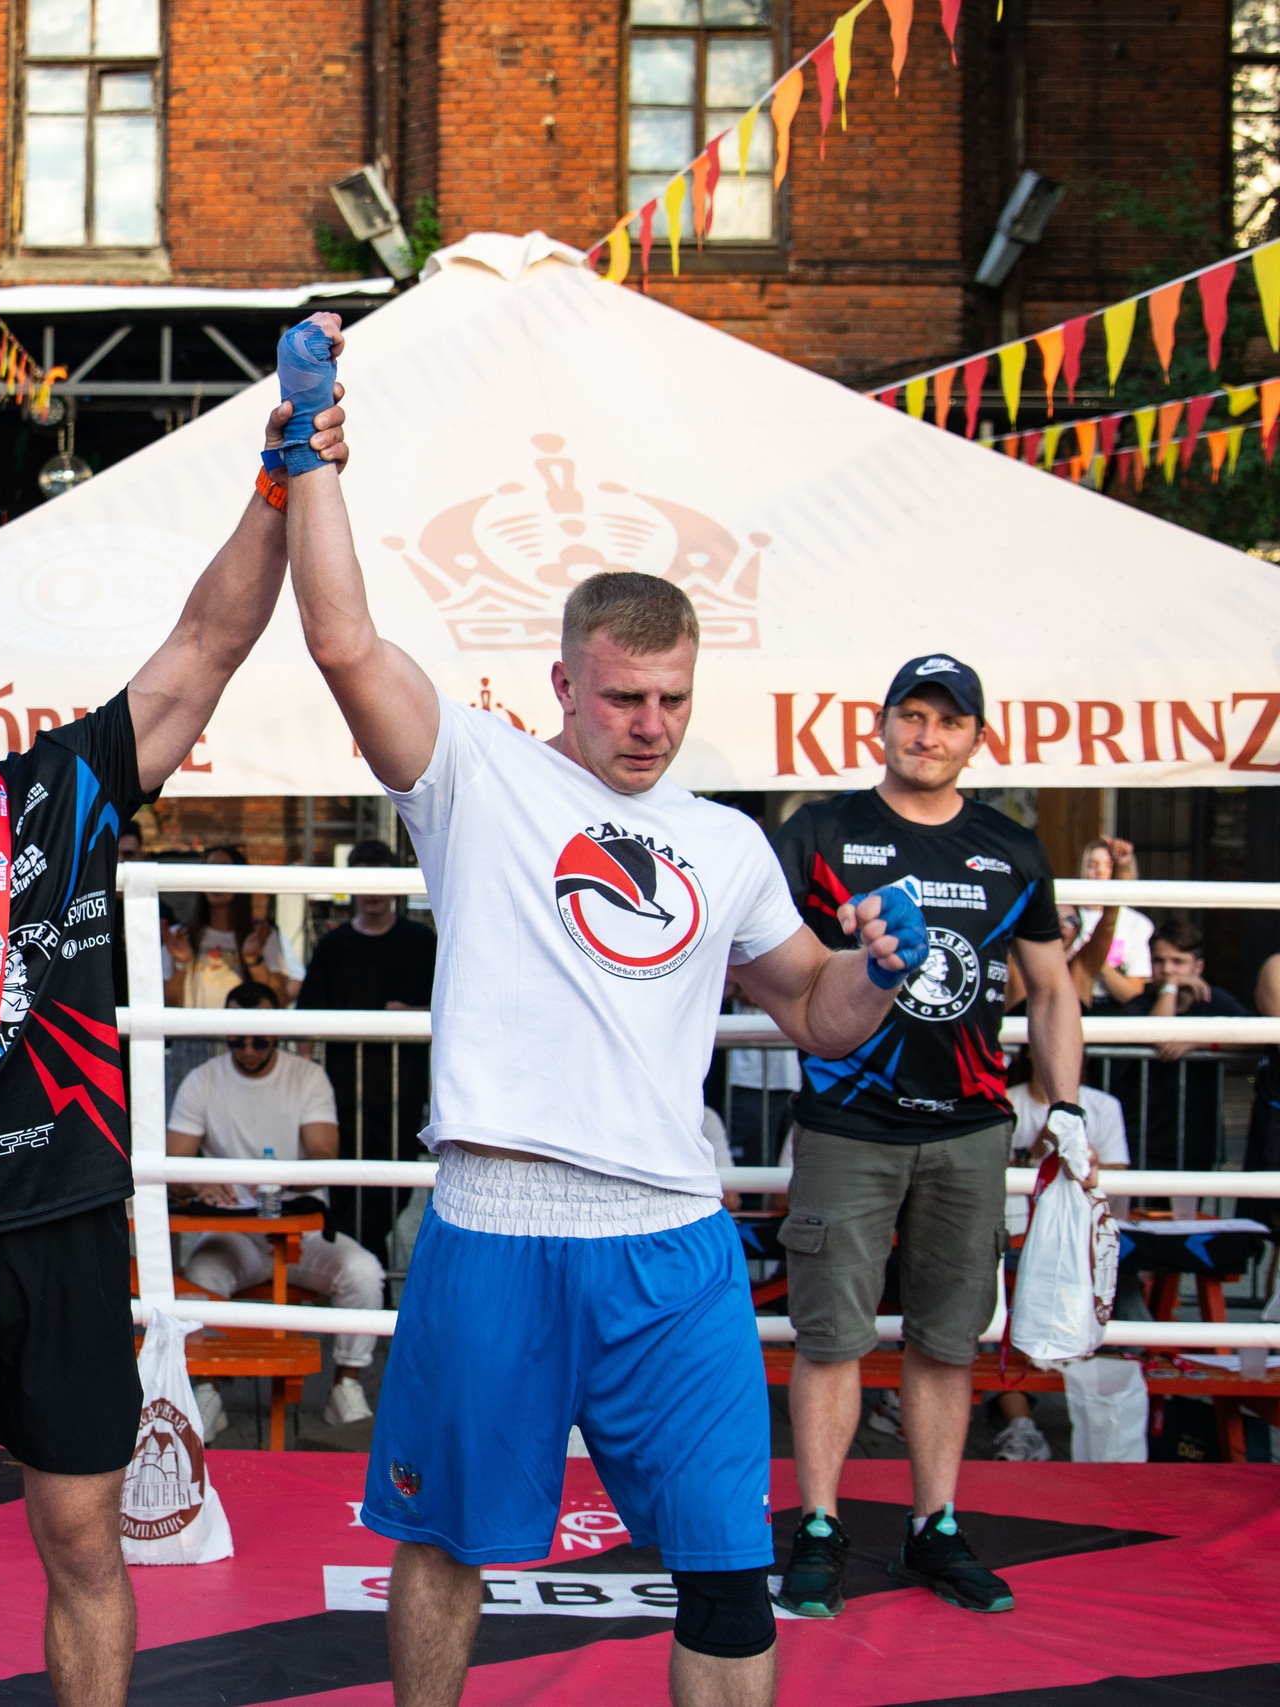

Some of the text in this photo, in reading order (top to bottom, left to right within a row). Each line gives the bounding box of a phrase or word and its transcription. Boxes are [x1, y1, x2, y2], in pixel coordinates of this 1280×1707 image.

[771, 692, 1280, 777] KRNPRINZ
[843, 843, 896, 857] АЛЕКСЕЙ
[922, 880, 986, 901] БИТВА
[78, 932, 111, 951] LADOG
[562, 907, 689, 978] АССОЦИАЦИЯ ОХРАННЫХ ПРЕДПРИЯТИЙ
[904, 997, 963, 1017] 2010
